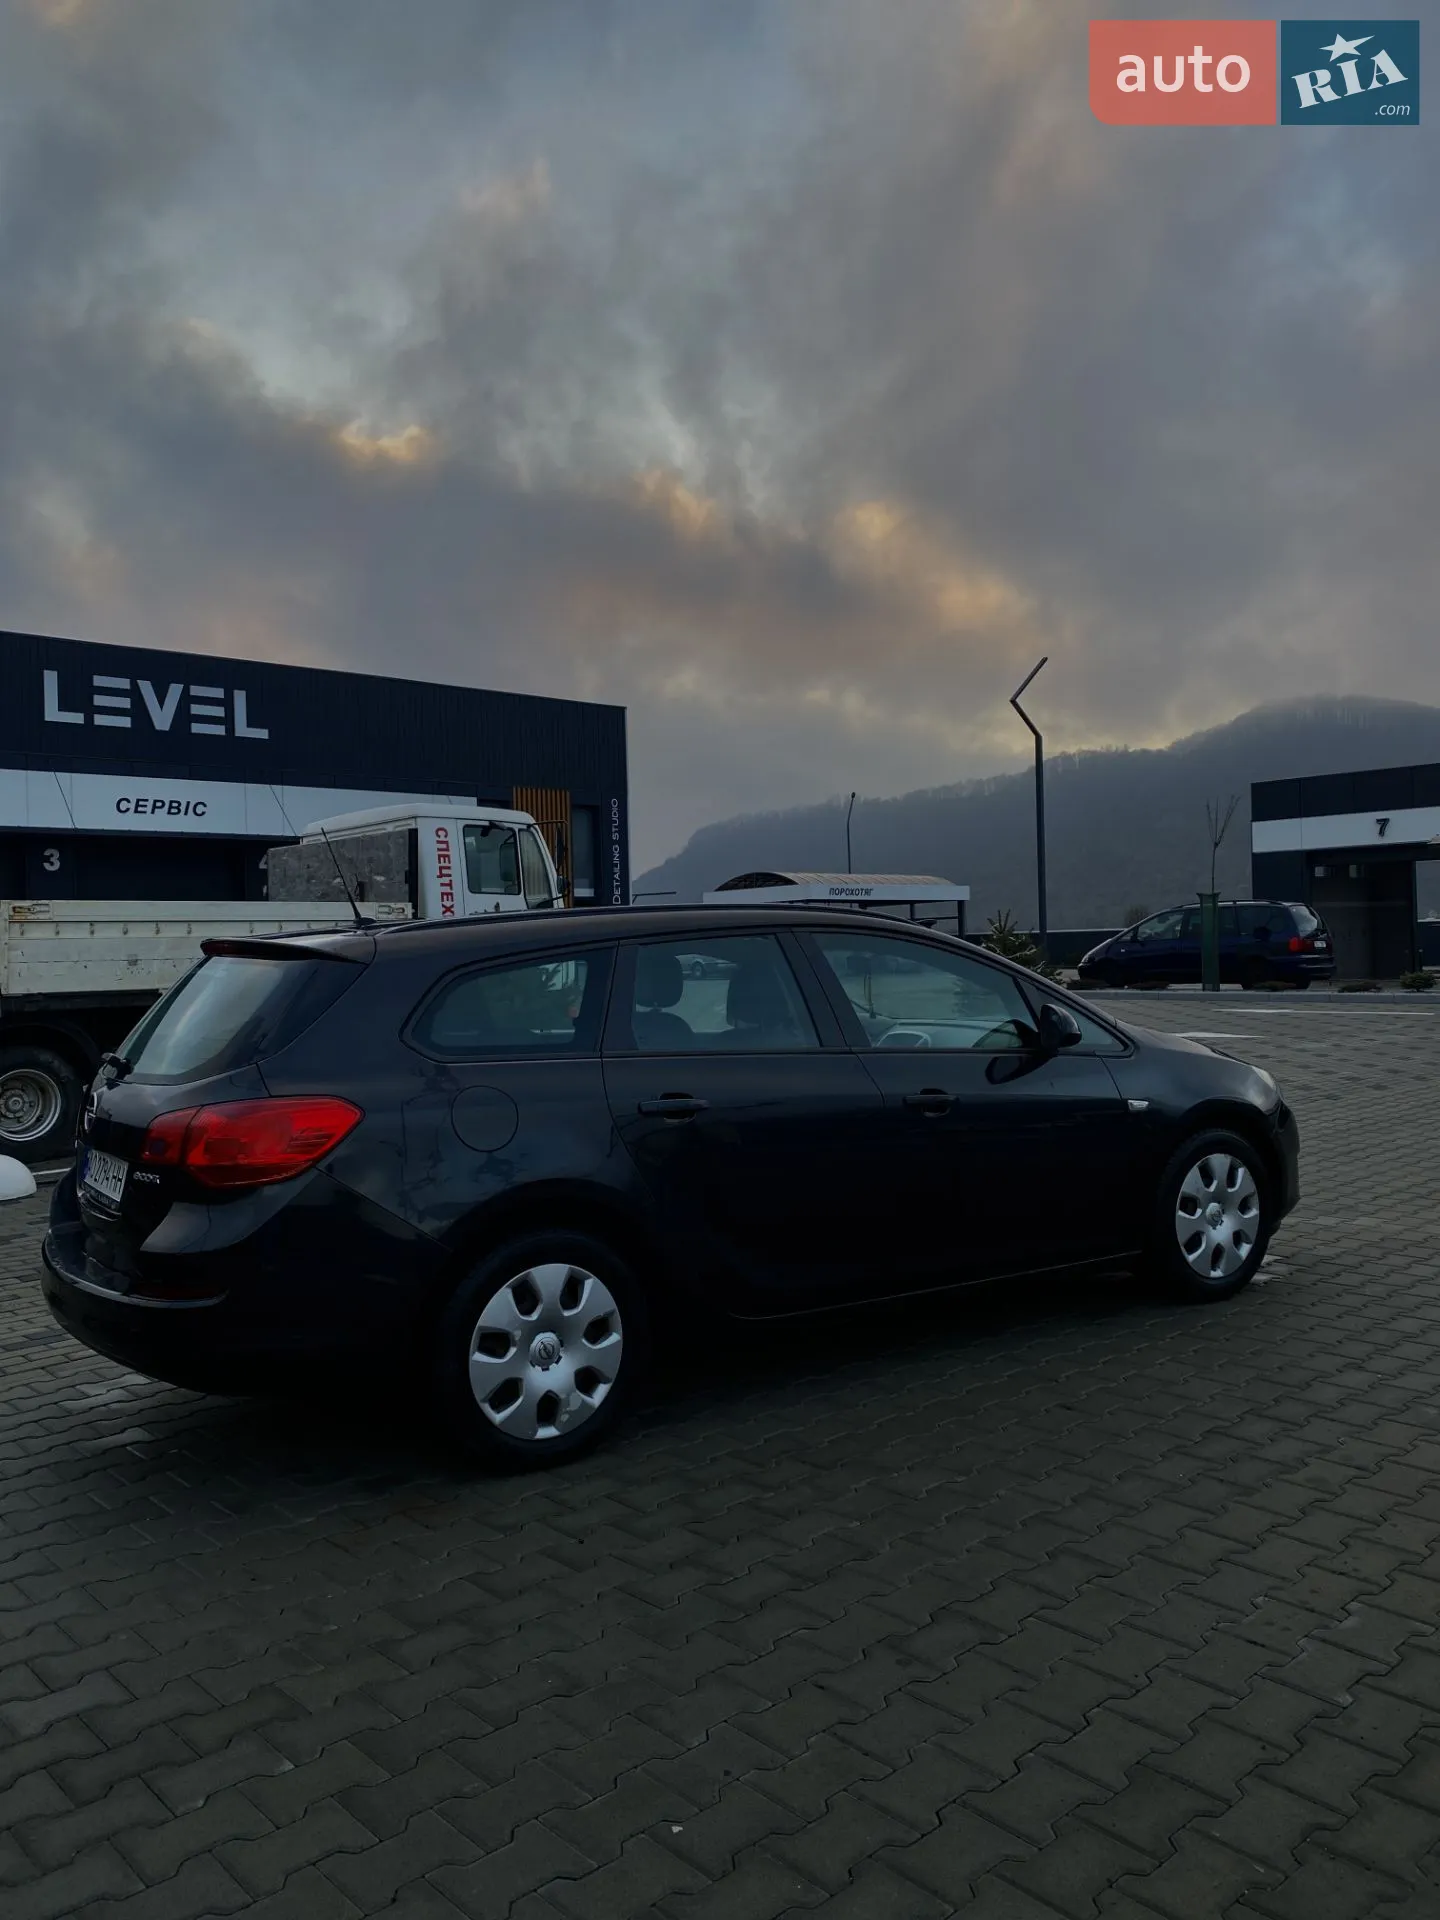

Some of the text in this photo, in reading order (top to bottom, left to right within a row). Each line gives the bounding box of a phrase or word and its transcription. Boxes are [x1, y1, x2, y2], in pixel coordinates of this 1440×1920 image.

[43, 669, 270, 741] LEVEL
[115, 797, 208, 817] СЕРВІС
[1376, 818, 1390, 837] 7
[42, 848, 61, 872] 3
[611, 798, 622, 905] DETAILING STUDIO
[828, 888, 874, 897] ПОРОХОТЯГ
